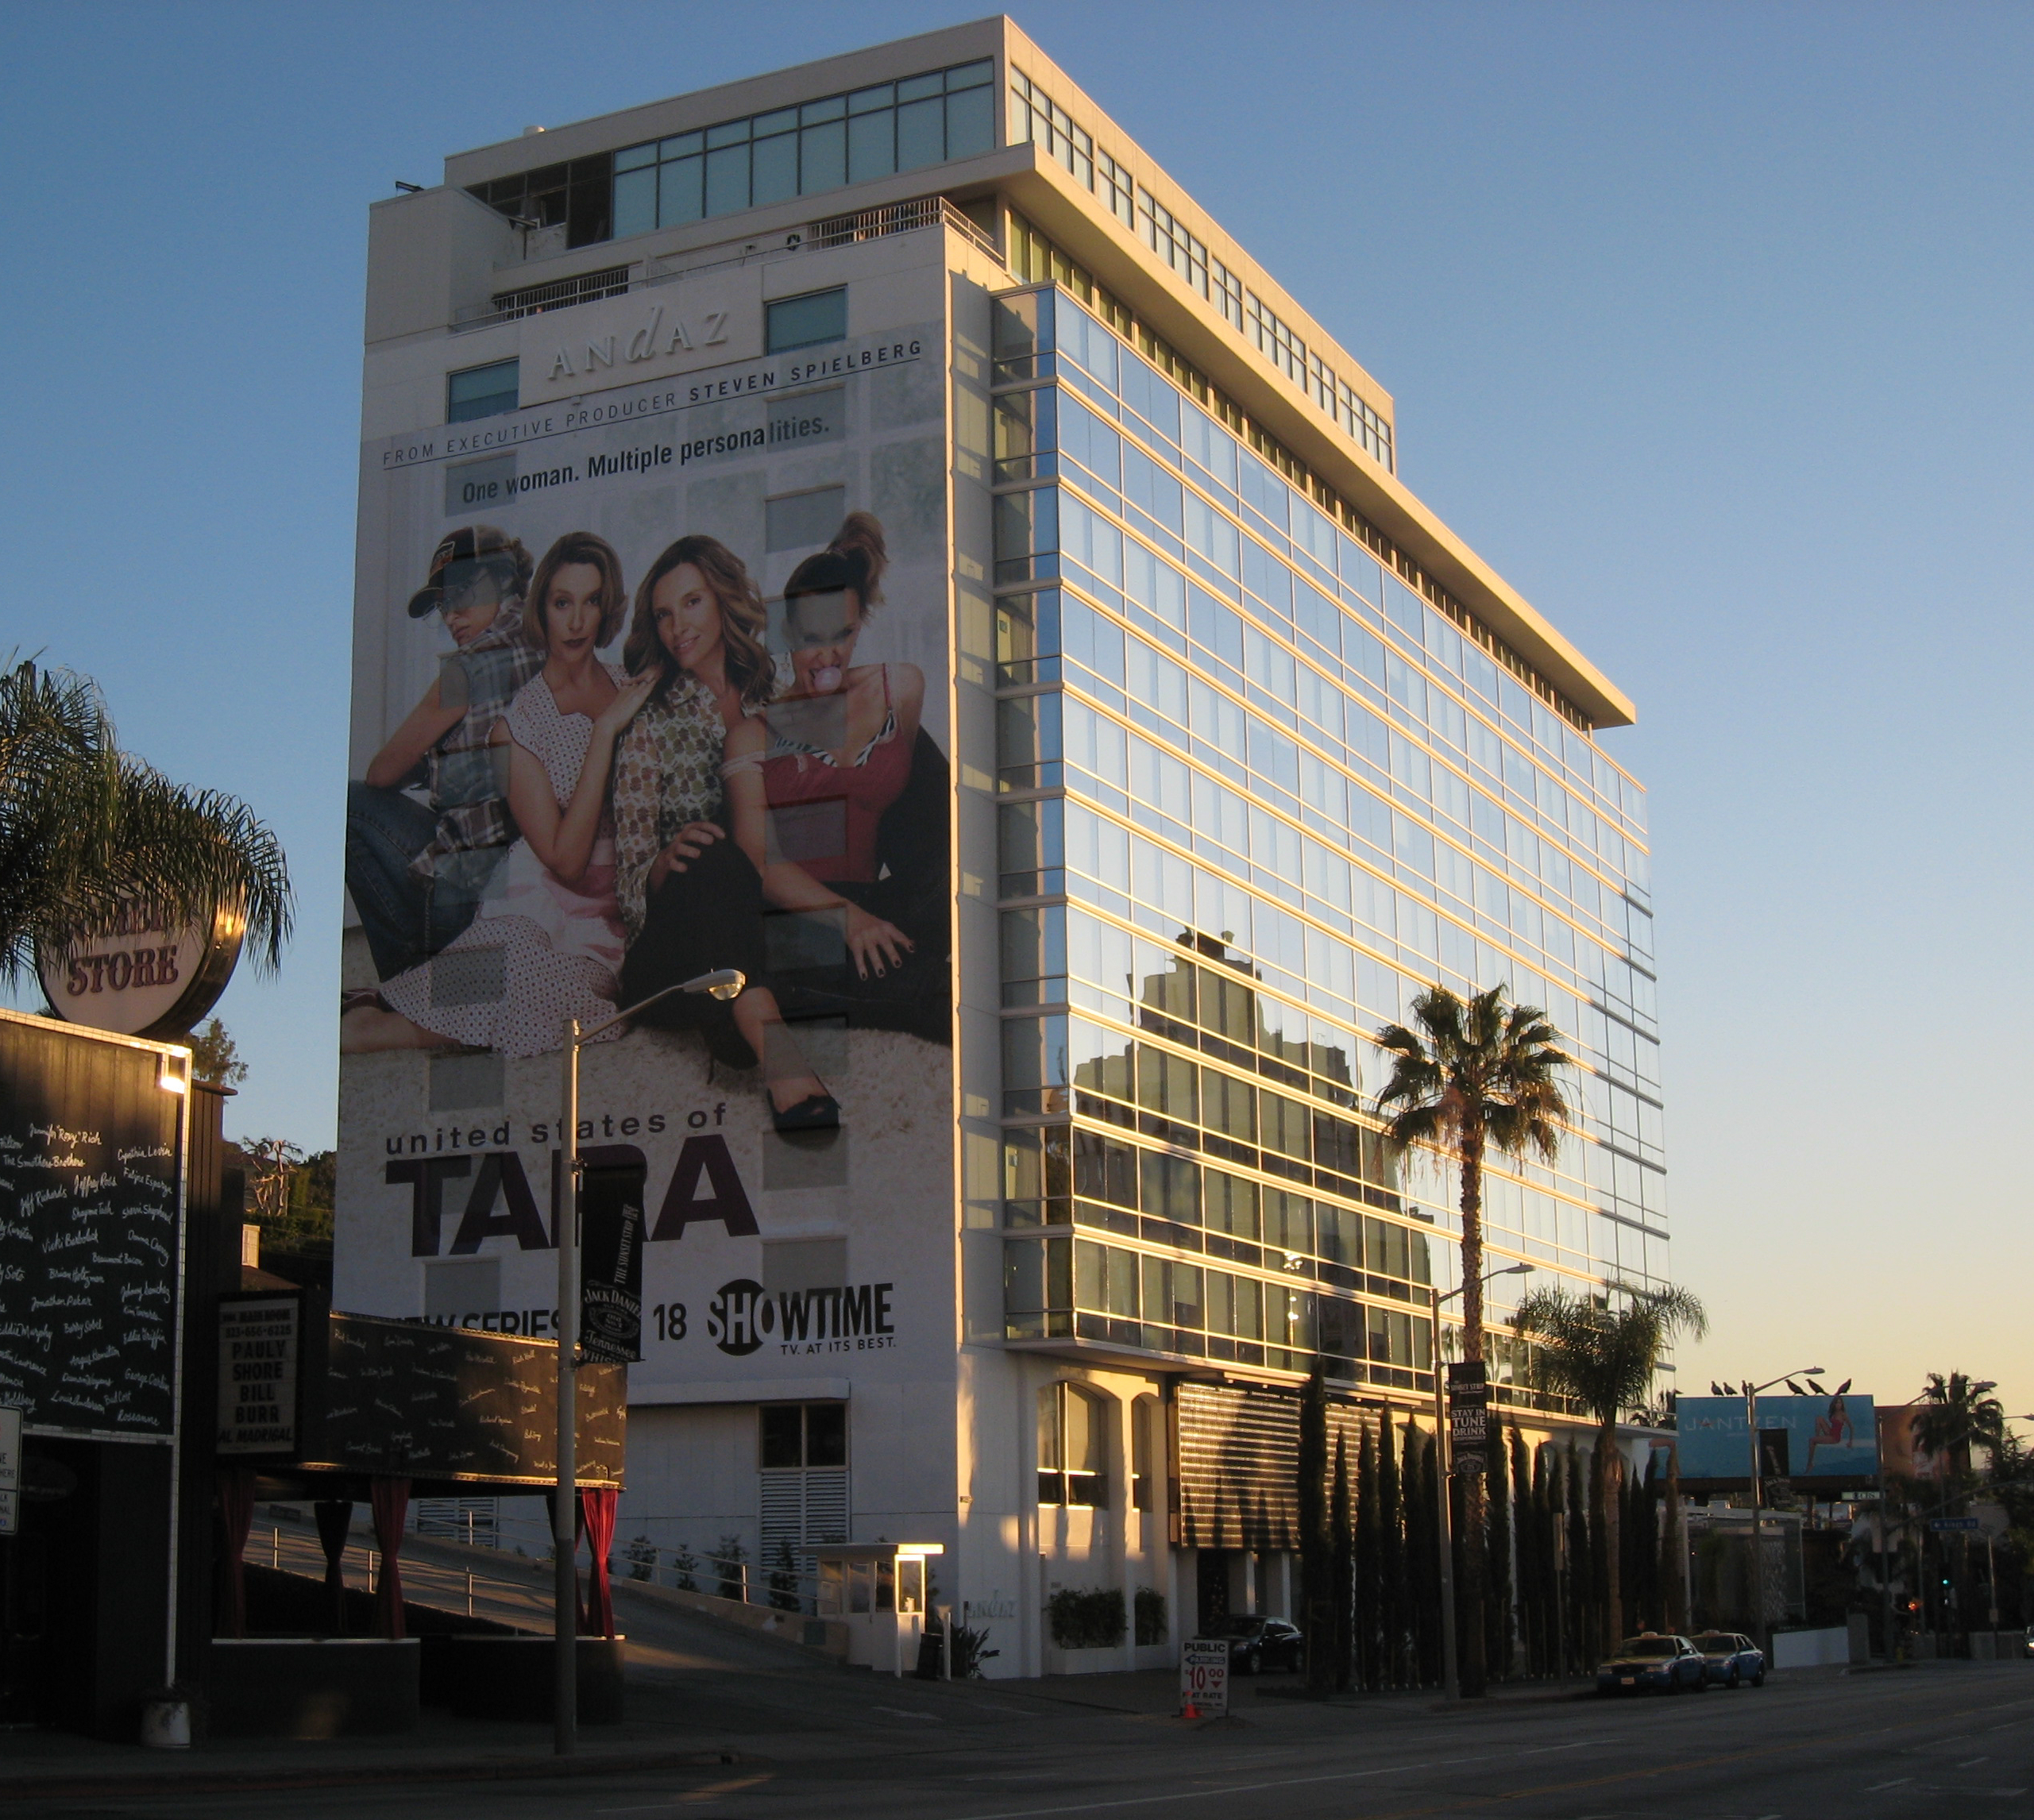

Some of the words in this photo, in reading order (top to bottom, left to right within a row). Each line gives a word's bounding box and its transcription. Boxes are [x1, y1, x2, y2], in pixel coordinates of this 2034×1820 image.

[383, 443, 434, 465] FROM
[447, 418, 554, 453] EXECUTIVE
[566, 392, 676, 428] PRODUCER
[689, 372, 775, 403] STEVEN
[791, 340, 922, 382] SPIELBERG
[462, 480, 498, 503] One
[506, 465, 580, 495] woman.
[588, 444, 673, 479] Multiple
[681, 415, 830, 466] personalities.
[67, 944, 179, 996] STORE
[387, 1121, 511, 1156] united
[531, 1113, 667, 1144] states
[687, 1103, 728, 1129] of
[3, 1154, 16, 1166] The
[623, 1219, 635, 1240] STRIP
[617, 1237, 631, 1268] SUNSET
[614, 1266, 627, 1284] THE
[585, 1288, 611, 1304] JACK
[611, 1289, 642, 1320] DANIE
[653, 1302, 688, 1349] 18
[707, 1279, 895, 1356] SHOWTIME
[233, 1340, 286, 1360] PAULY
[585, 1329, 637, 1360] Tennessee
[781, 1344, 802, 1355] TV.
[806, 1342, 823, 1354] AT
[828, 1340, 851, 1353] ITS
[857, 1336, 897, 1350] BEST.
[233, 1362, 283, 1382] SHORE
[241, 1384, 275, 1402] BILL
[235, 1405, 280, 1424] BURR
[1452, 1417, 1486, 1428] TUNE
[1684, 1416, 1797, 1432] JANTEN
[218, 1430, 234, 1444] AL
[235, 1429, 293, 1444] MADRIGAL
[1453, 1427, 1487, 1436] DRINK
[1184, 1642, 1225, 1652] PUBLIC
